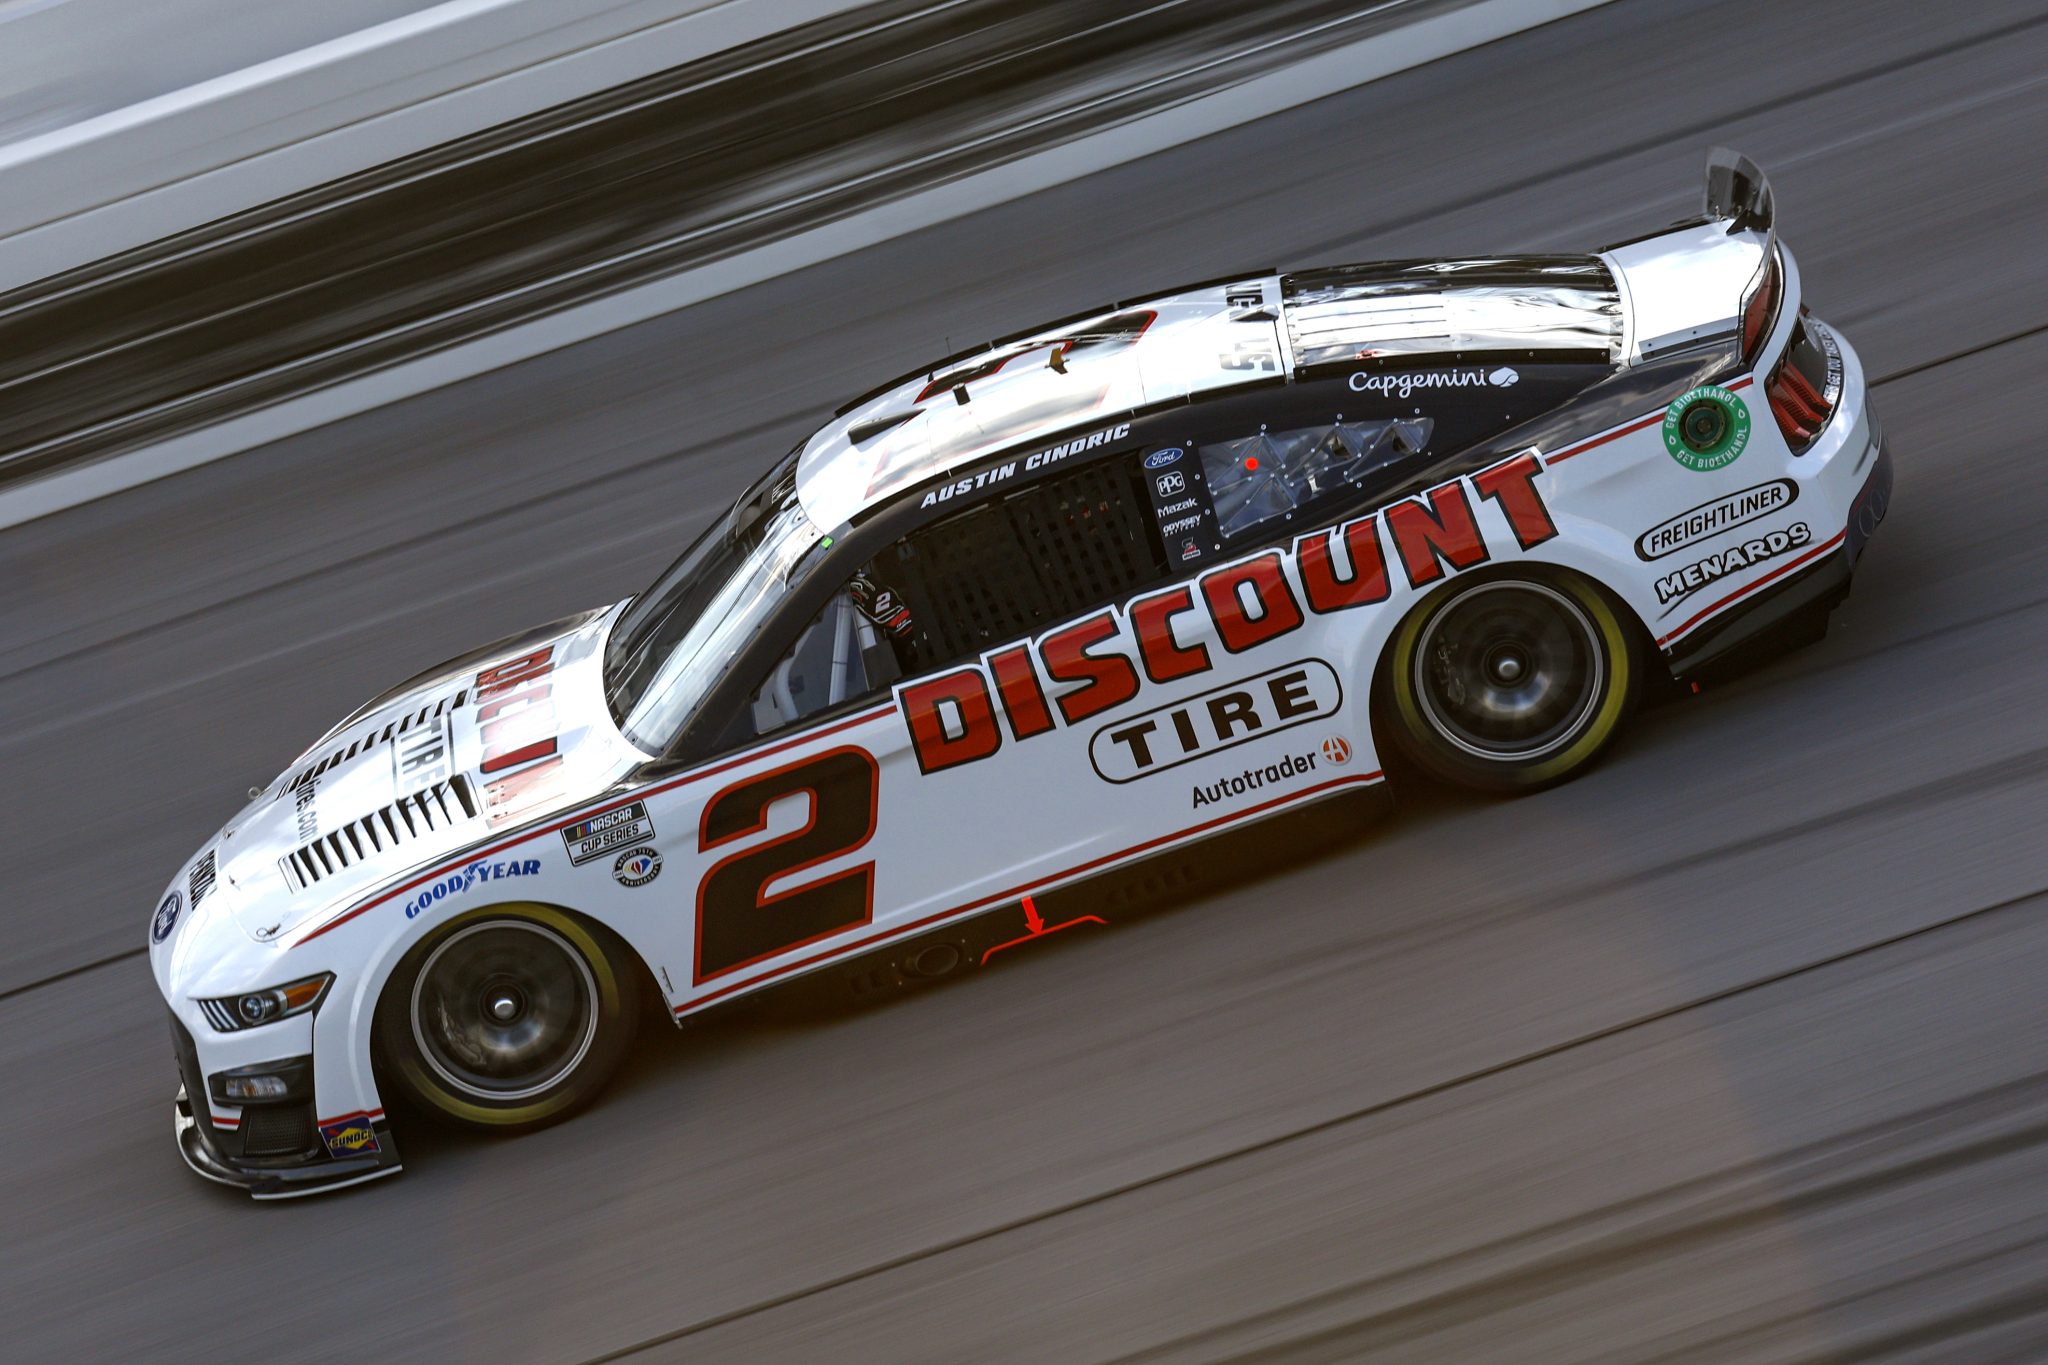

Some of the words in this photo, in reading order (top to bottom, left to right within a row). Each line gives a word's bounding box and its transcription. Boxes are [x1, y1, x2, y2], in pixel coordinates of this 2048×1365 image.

[1349, 369, 1487, 399] Capgemini
[1665, 409, 1679, 429] GET
[1674, 387, 1737, 410] BIOETHANOL
[921, 462, 1016, 510] AUSTIN
[1025, 423, 1131, 471] CINDRIC
[1150, 450, 1178, 467] Ford
[1676, 450, 1696, 466] GET
[1697, 425, 1748, 469] BIOETHANOL
[1159, 475, 1183, 493] PPG
[1157, 498, 1198, 518] Mazak
[1163, 514, 1201, 534] ODYSSEY
[1651, 487, 1783, 553] FREIGHTLINER
[1654, 522, 1812, 605] MENARDS
[899, 449, 1560, 776] DISCOUNT
[1110, 669, 1320, 770] TIRE
[1193, 752, 1317, 809] Autotrader
[581, 837, 602, 854] CUP
[603, 823, 639, 848] SERIES
[590, 807, 633, 833] NASCAR
[692, 744, 880, 988] 2
[405, 859, 541, 919] GOODYEAR
[329, 1128, 375, 1150] SUNOCO
